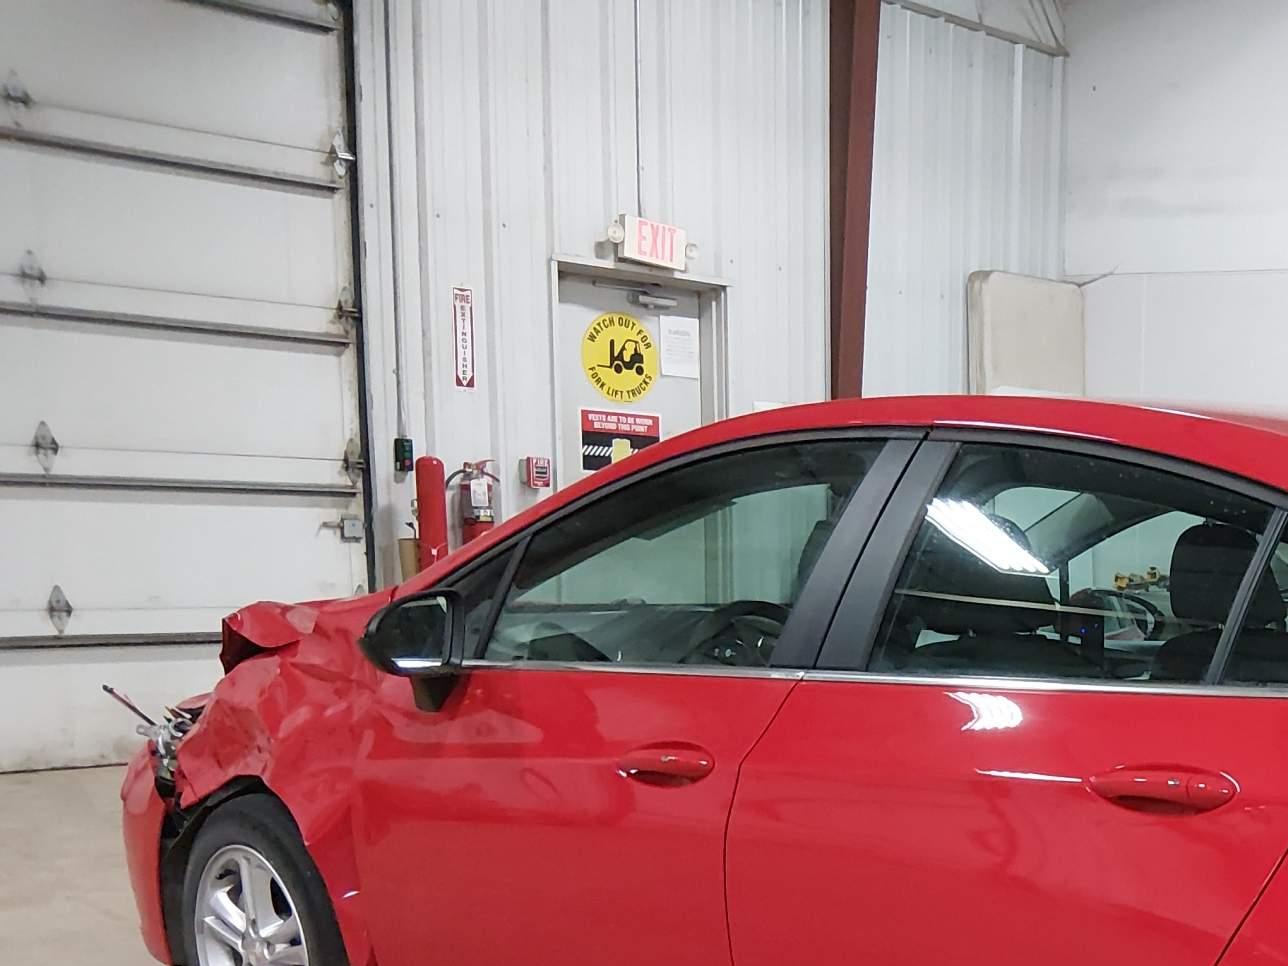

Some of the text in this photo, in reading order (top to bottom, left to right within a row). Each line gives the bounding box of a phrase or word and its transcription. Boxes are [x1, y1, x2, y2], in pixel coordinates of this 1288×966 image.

[638, 219, 677, 262] EXIT
[454, 293, 471, 304] FIRE
[587, 316, 615, 343] WATCH
[618, 316, 636, 332] OUT
[636, 329, 652, 350] FOR
[588, 366, 653, 400] FORK LIFT TRUCKS
